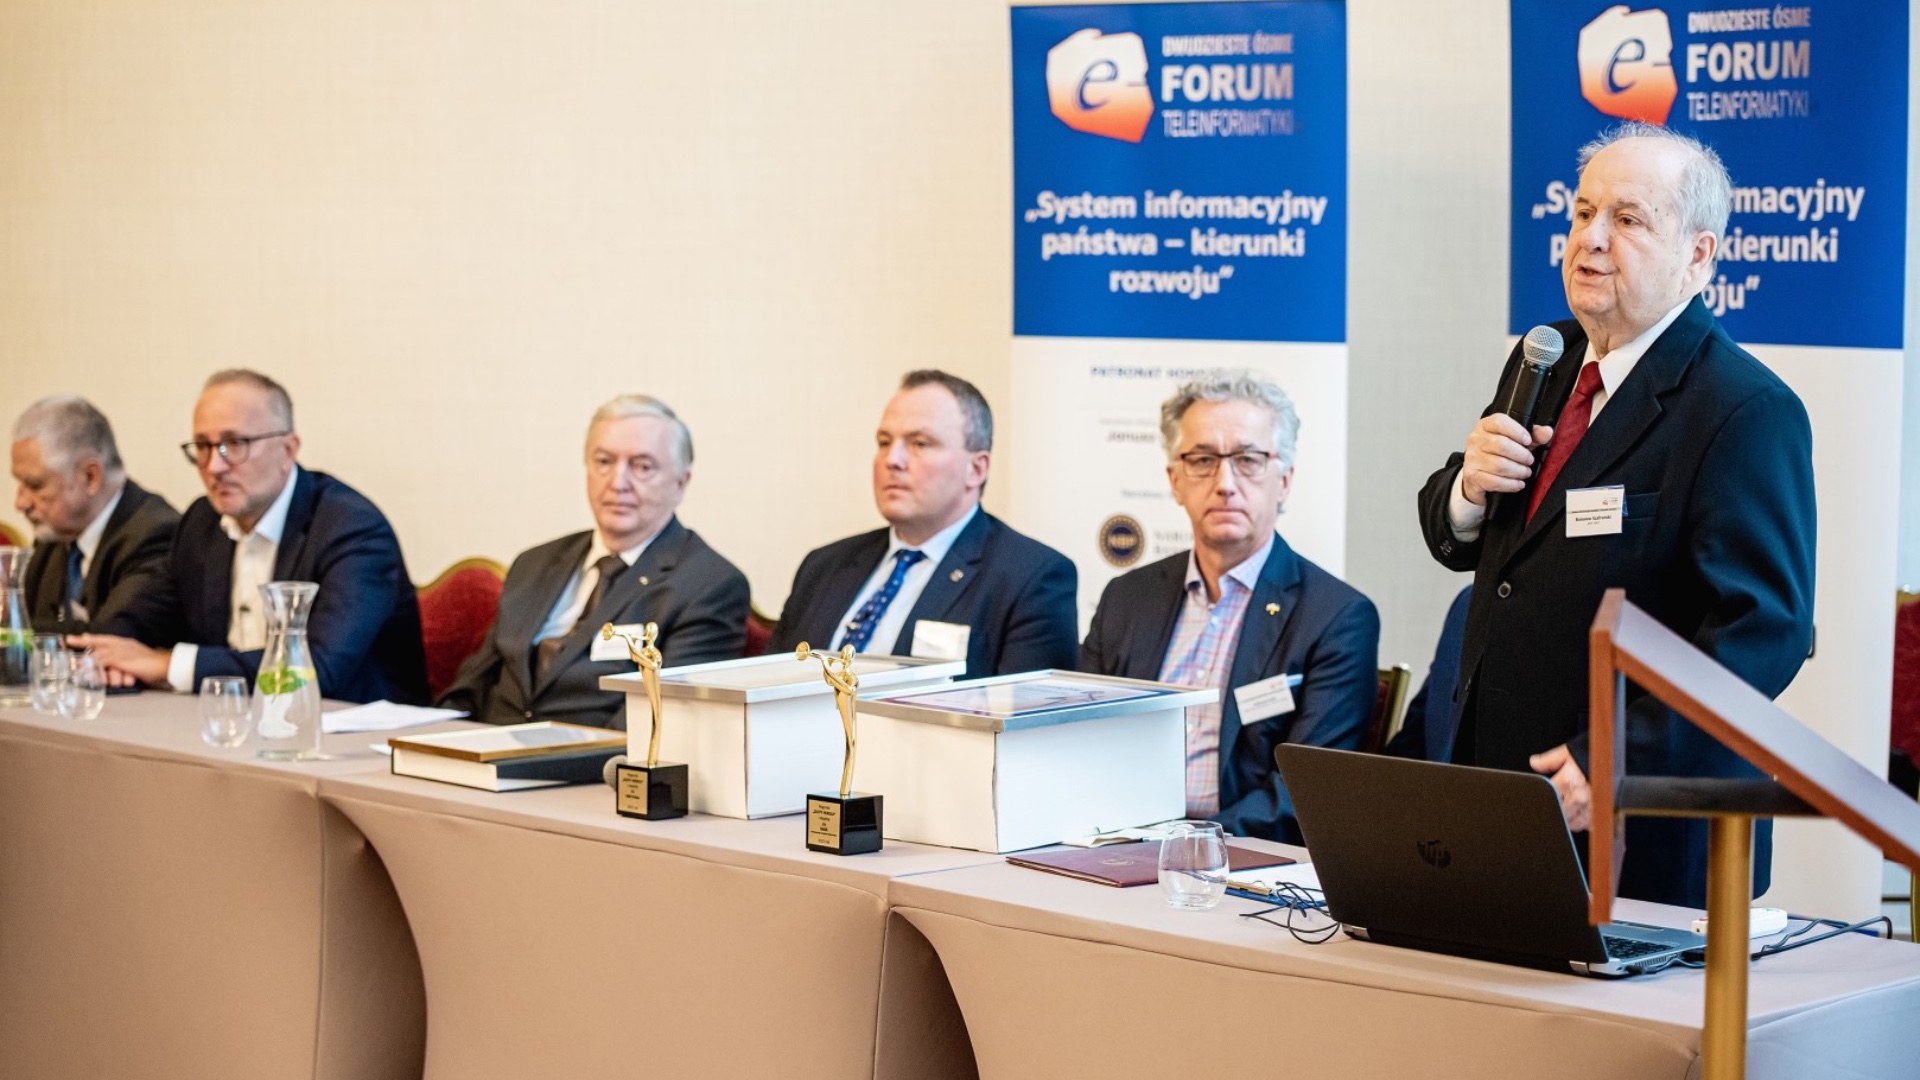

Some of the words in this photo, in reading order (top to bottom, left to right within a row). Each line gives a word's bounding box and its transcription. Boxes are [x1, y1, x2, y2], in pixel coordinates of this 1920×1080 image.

[1687, 8, 1771, 33] DWUDZIESTE
[1772, 3, 1811, 29] ÓSME
[1687, 40, 1810, 83] FORUM
[1161, 63, 1293, 102] FORUM
[1024, 190, 1137, 225] „System
[1144, 189, 1328, 225] informacyjny
[1730, 178, 1866, 222] macyjny
[1041, 225, 1158, 261] państwa
[1190, 227, 1305, 257] kierunki
